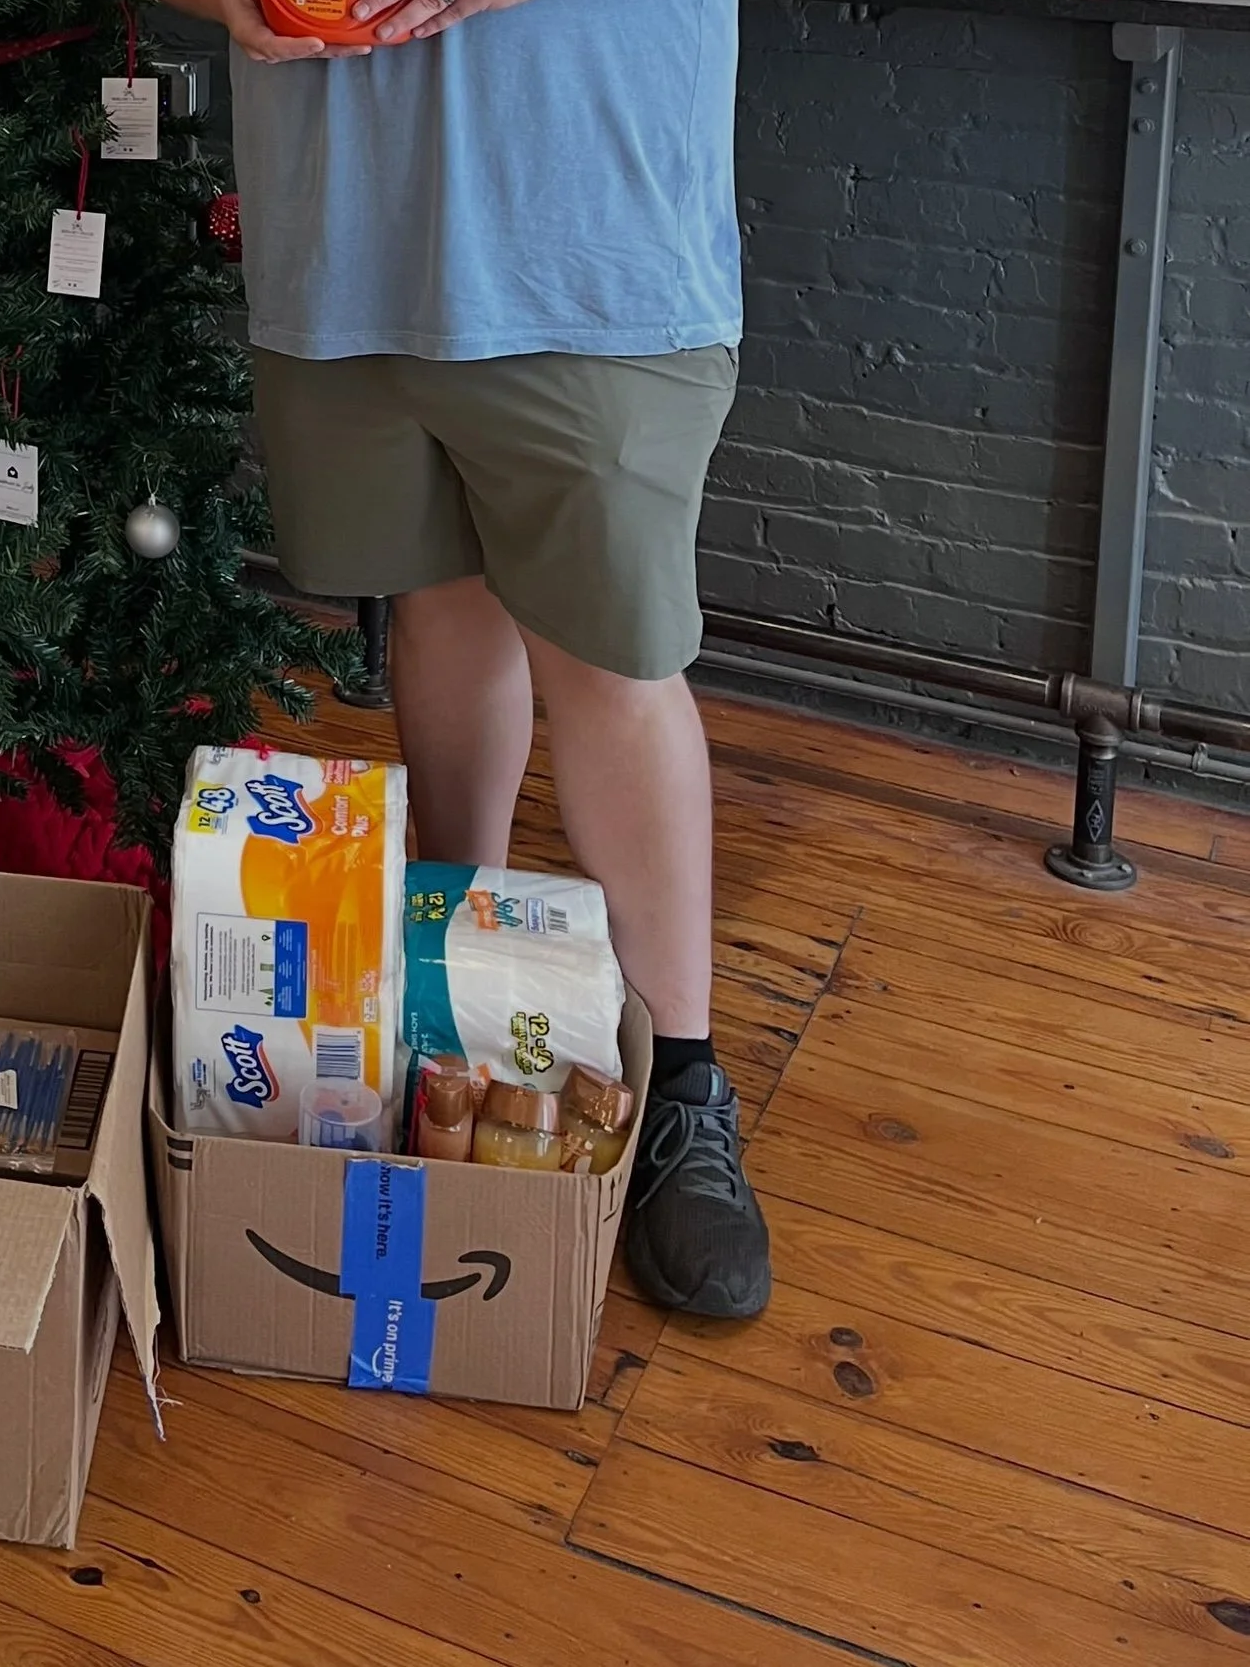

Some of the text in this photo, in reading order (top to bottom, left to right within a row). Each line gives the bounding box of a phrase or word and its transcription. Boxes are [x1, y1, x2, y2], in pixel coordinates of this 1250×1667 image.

[198, 787, 234, 827] 12 48
[246, 780, 308, 832] Scott
[331, 794, 350, 835] Comfort
[351, 814, 370, 837] Plus
[528, 1013, 549, 1036] 12
[222, 1036, 269, 1098] Scott
[378, 1199, 392, 1222] it's
[375, 1223, 389, 1261] here.
[382, 1299, 403, 1384] It's on prime
